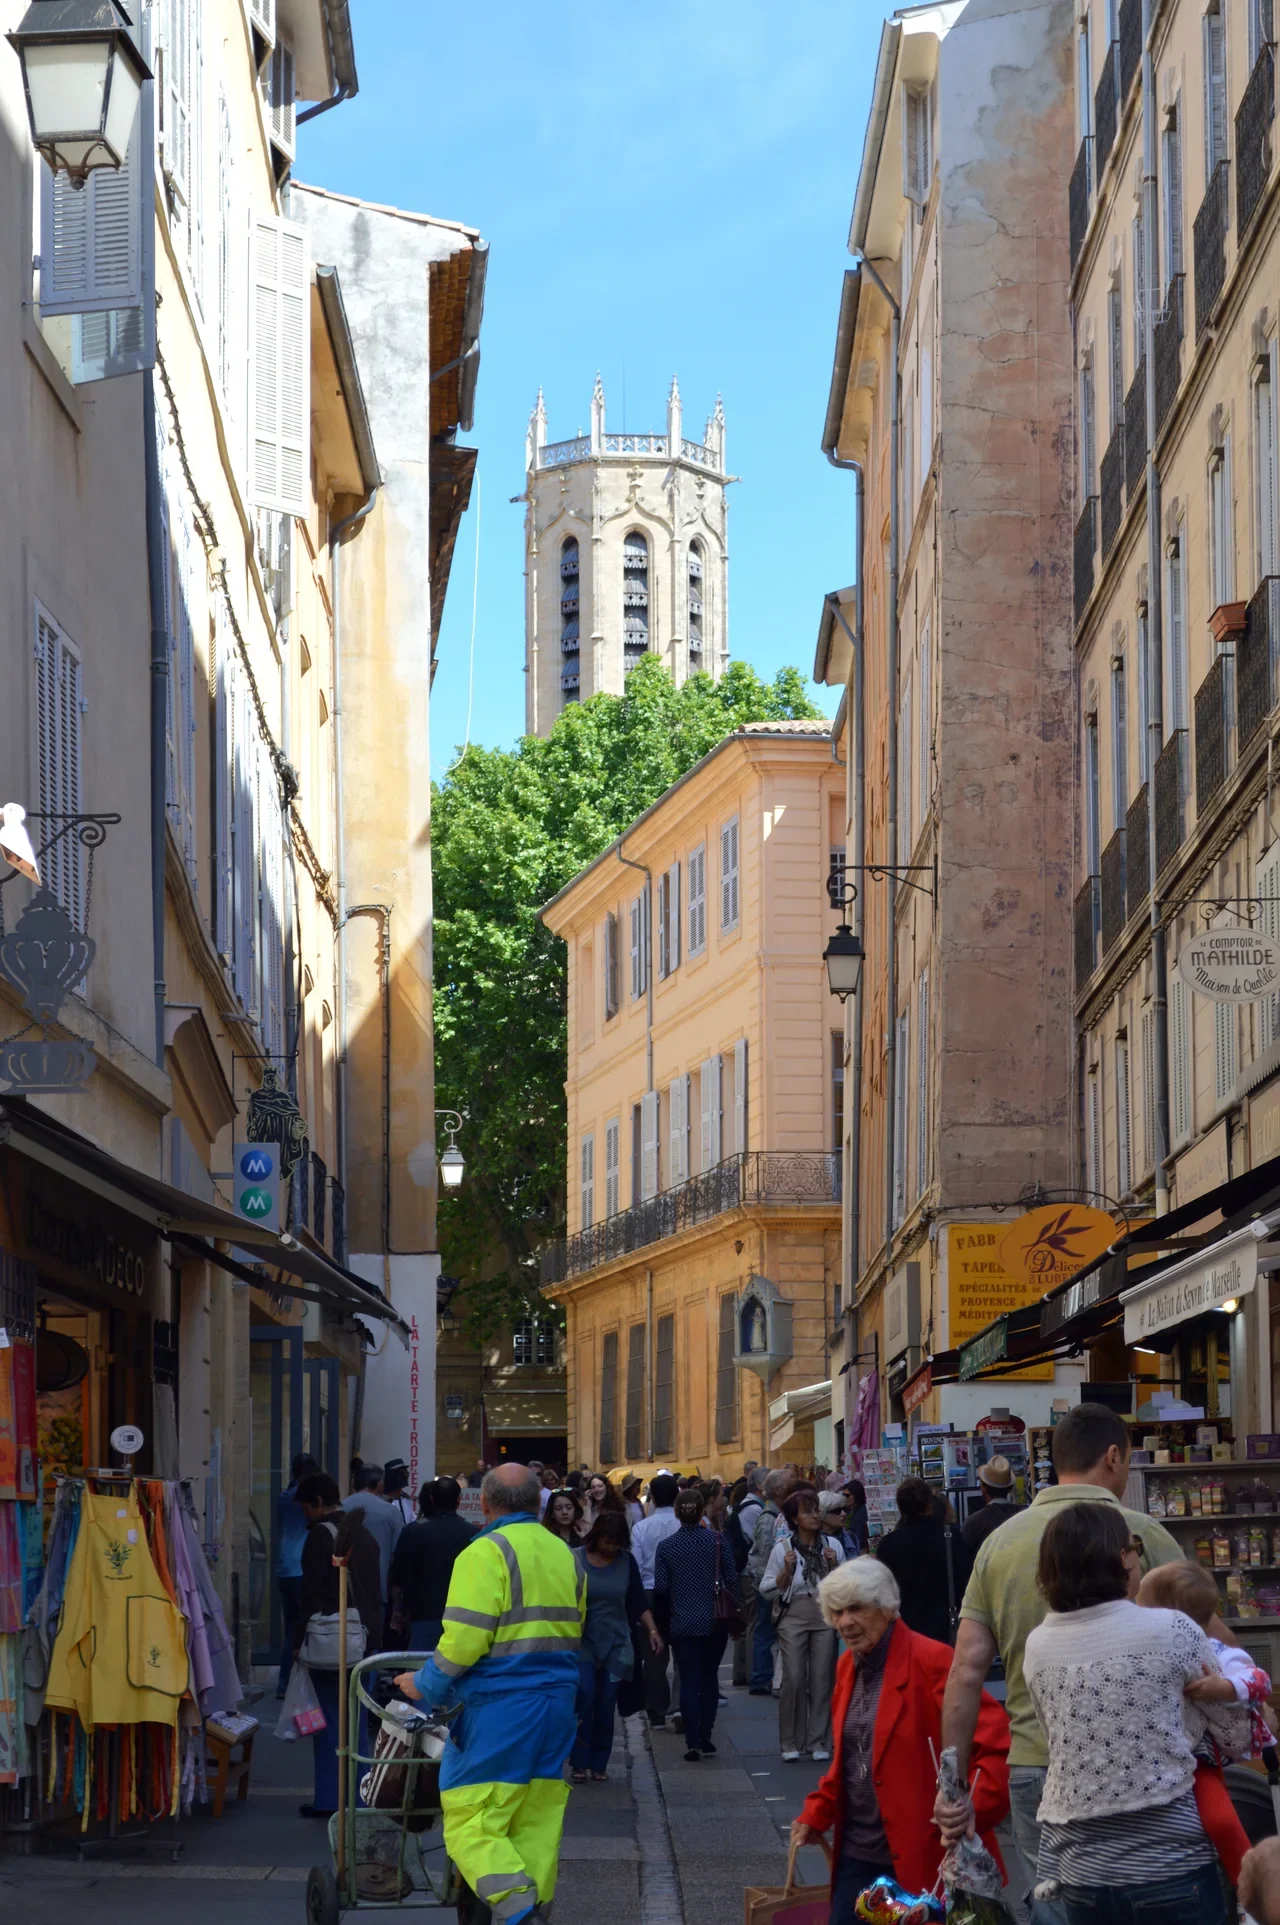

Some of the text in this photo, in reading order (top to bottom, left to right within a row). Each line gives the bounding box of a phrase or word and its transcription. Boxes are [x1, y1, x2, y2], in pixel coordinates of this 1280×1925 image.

[1209, 937, 1254, 949] COMPTOIR
[1191, 949, 1275, 966] MATHILDE
[1195, 966, 1278, 995] Maison de Qualité
[1038, 1273, 1072, 1284] LUBE
[959, 1282, 1027, 1293] SPÉCIALITÉS
[960, 1297, 1017, 1307] PROVENCE
[410, 1315, 419, 1512] LA TARTE TROPÉZI
[920, 1436, 945, 1445] PROVENC
[472, 1492, 480, 1501] TA
[458, 1502, 482, 1511] OPÉZI
